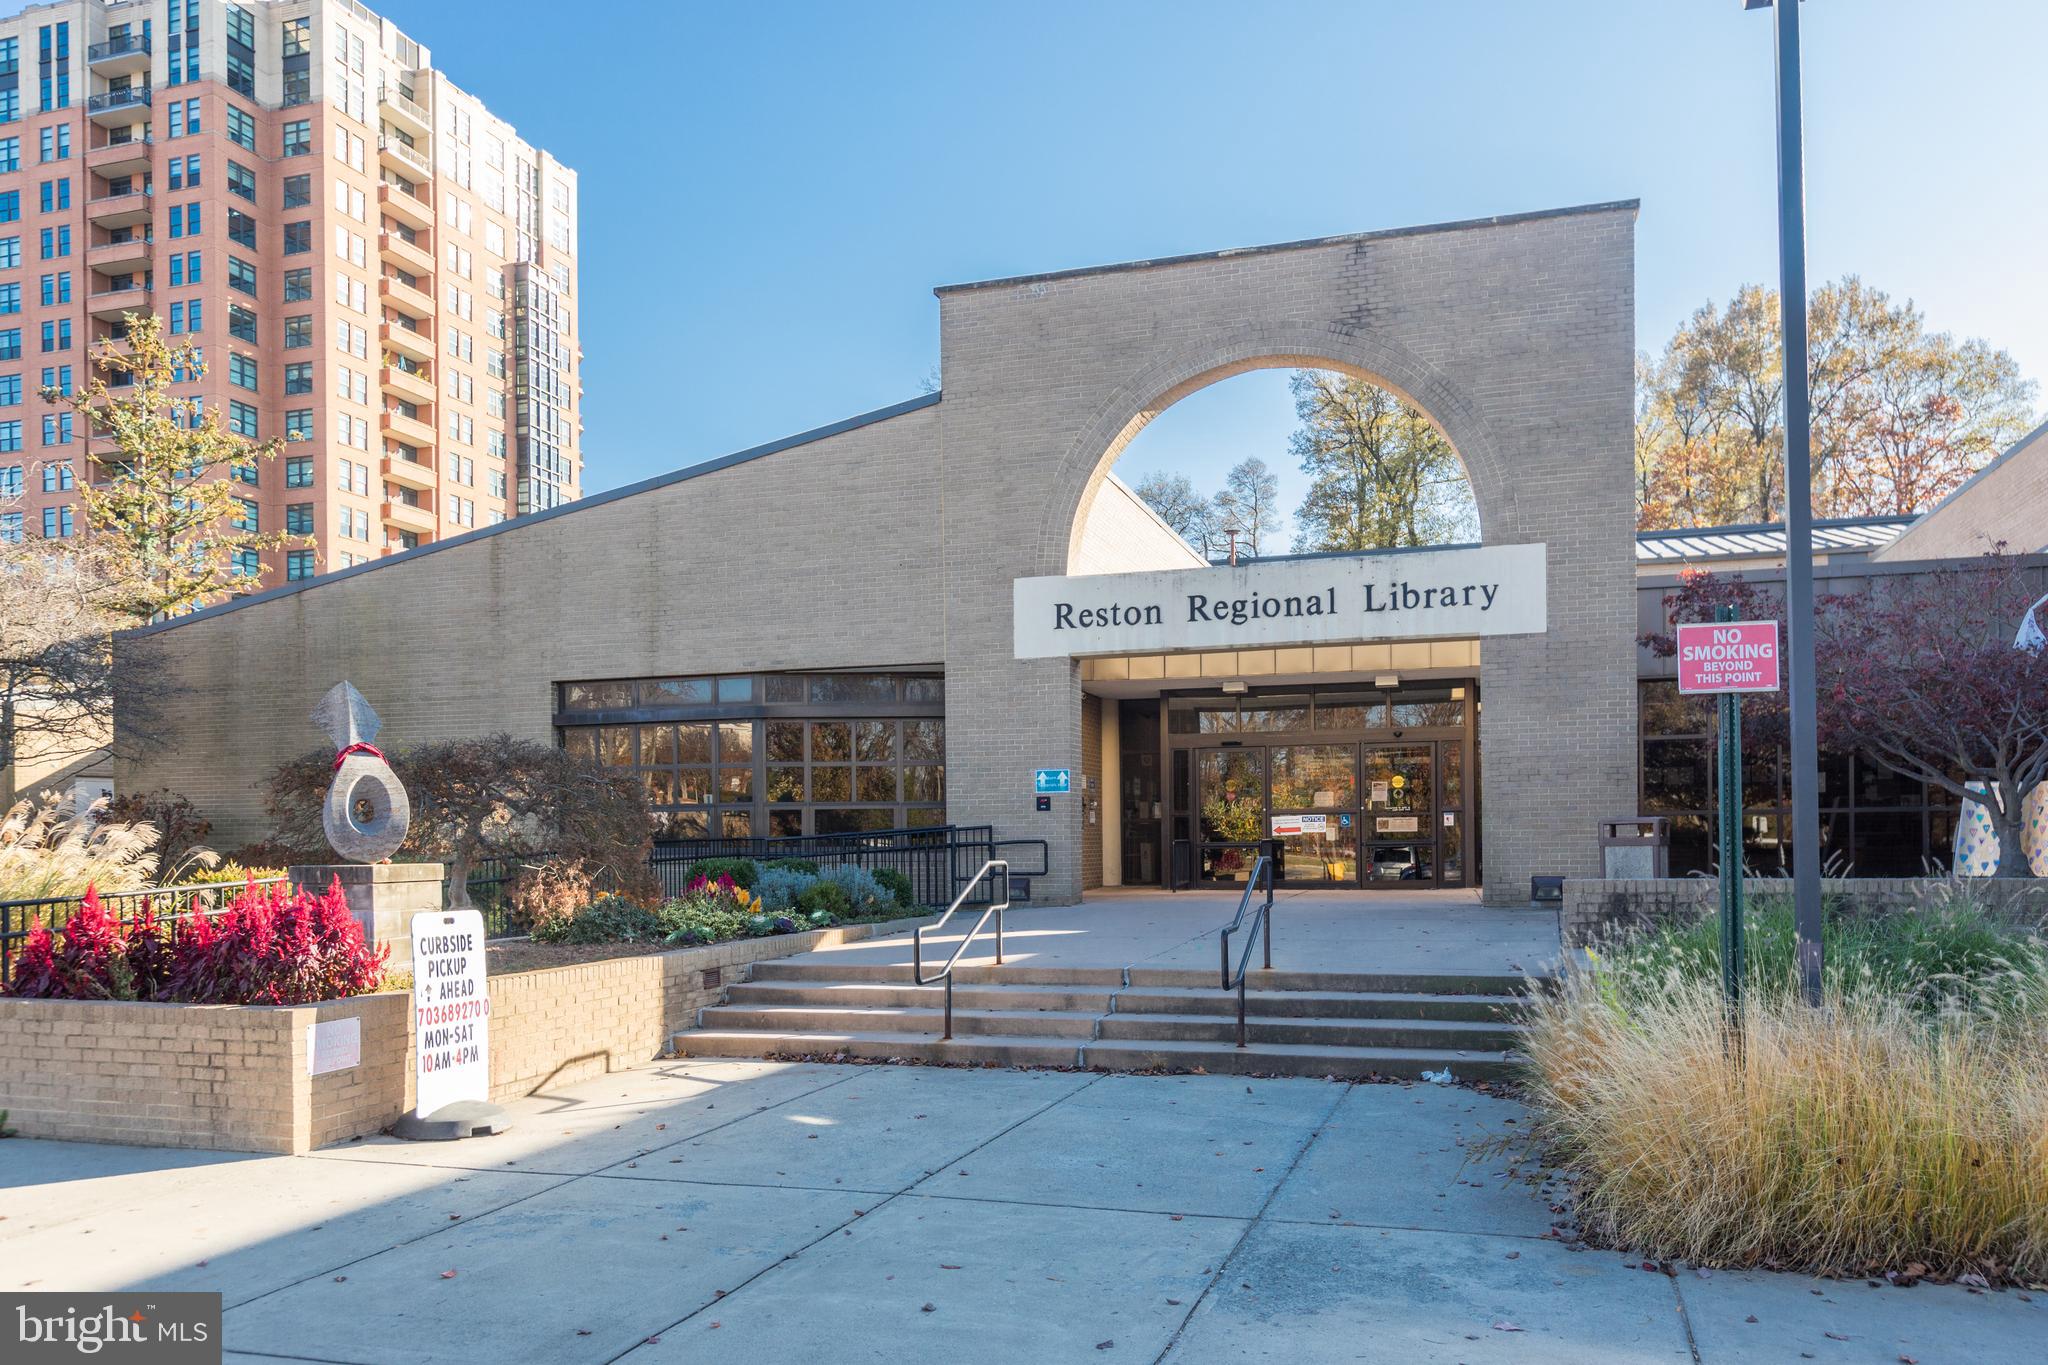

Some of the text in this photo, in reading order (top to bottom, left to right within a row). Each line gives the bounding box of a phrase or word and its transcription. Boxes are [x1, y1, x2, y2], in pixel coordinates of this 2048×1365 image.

[1053, 578, 1500, 630] Reston Regional Library
[1713, 629, 1742, 644] NO
[1683, 643, 1773, 661] SMOKING
[1703, 660, 1753, 672] BEYOND
[1696, 671, 1762, 684] THIS POINT
[420, 934, 473, 955] CURBSIDE
[428, 957, 467, 978] PICKUP
[440, 979, 474, 1000] AHEAD
[425, 1024, 474, 1049] MON-SAT
